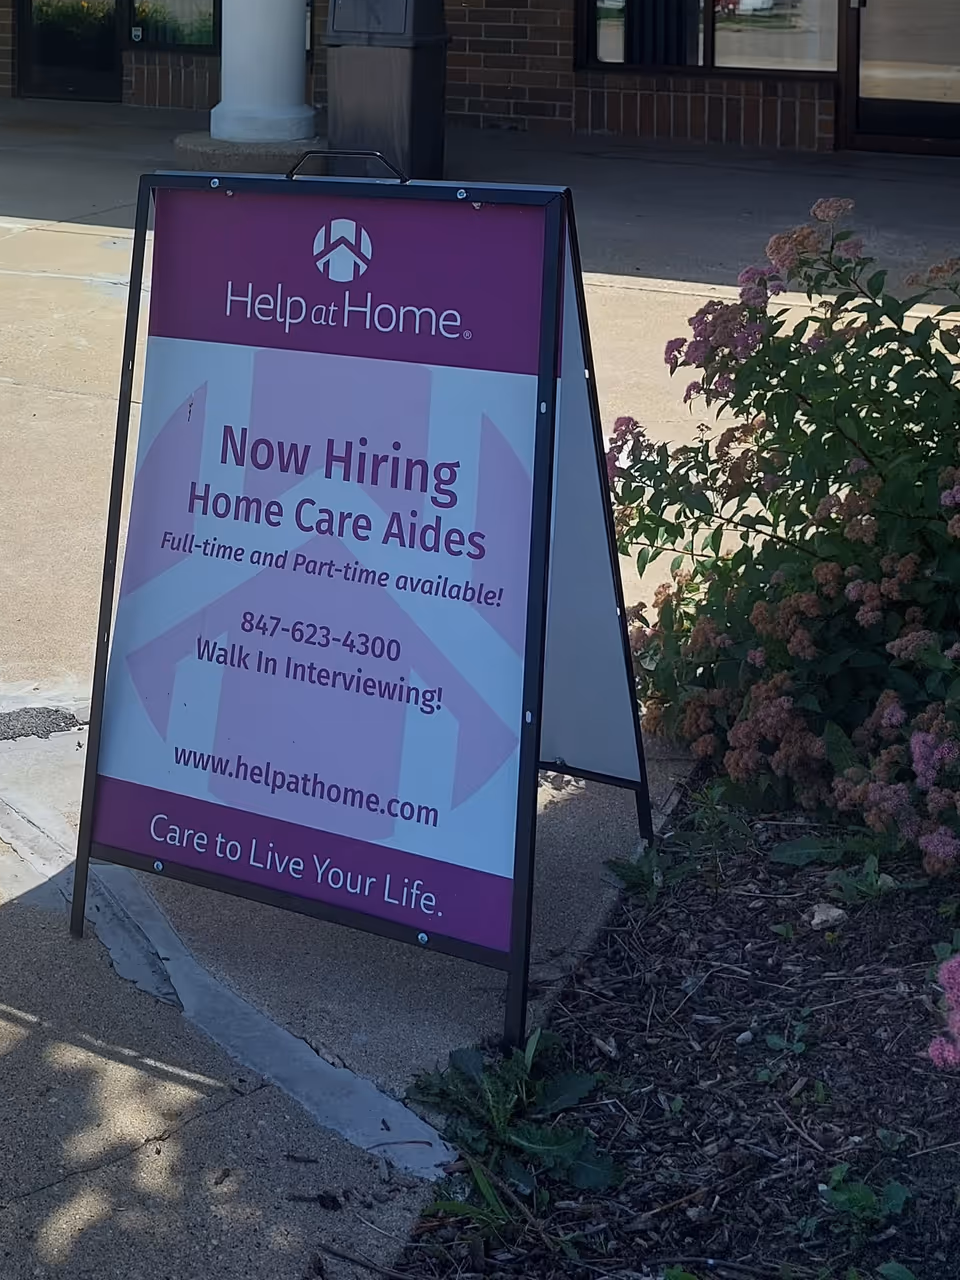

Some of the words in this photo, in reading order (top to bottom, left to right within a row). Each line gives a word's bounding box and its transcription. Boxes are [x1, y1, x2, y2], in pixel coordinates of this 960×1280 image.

[226, 281, 307, 333] Help
[311, 301, 338, 326] at
[220, 424, 311, 475] Now
[324, 436, 461, 509] Hiring
[187, 481, 284, 528] Home
[294, 497, 372, 541] Care
[381, 509, 486, 560] Aides
[160, 531, 245, 562] Full-time
[250, 549, 288, 570] and
[292, 553, 390, 588] Part-time
[395, 574, 504, 608] available!
[197, 635, 250, 670] Walk
[256, 650, 278, 676] In
[285, 656, 443, 715] Interviewing!
[240, 611, 401, 663] 847-623-4300
[174, 745, 439, 828] www.helpathome.com
[150, 814, 208, 852] Care
[215, 832, 241, 861] to
[249, 838, 304, 878] Live
[312, 854, 377, 896] Your
[384, 873, 443, 917] Life.
